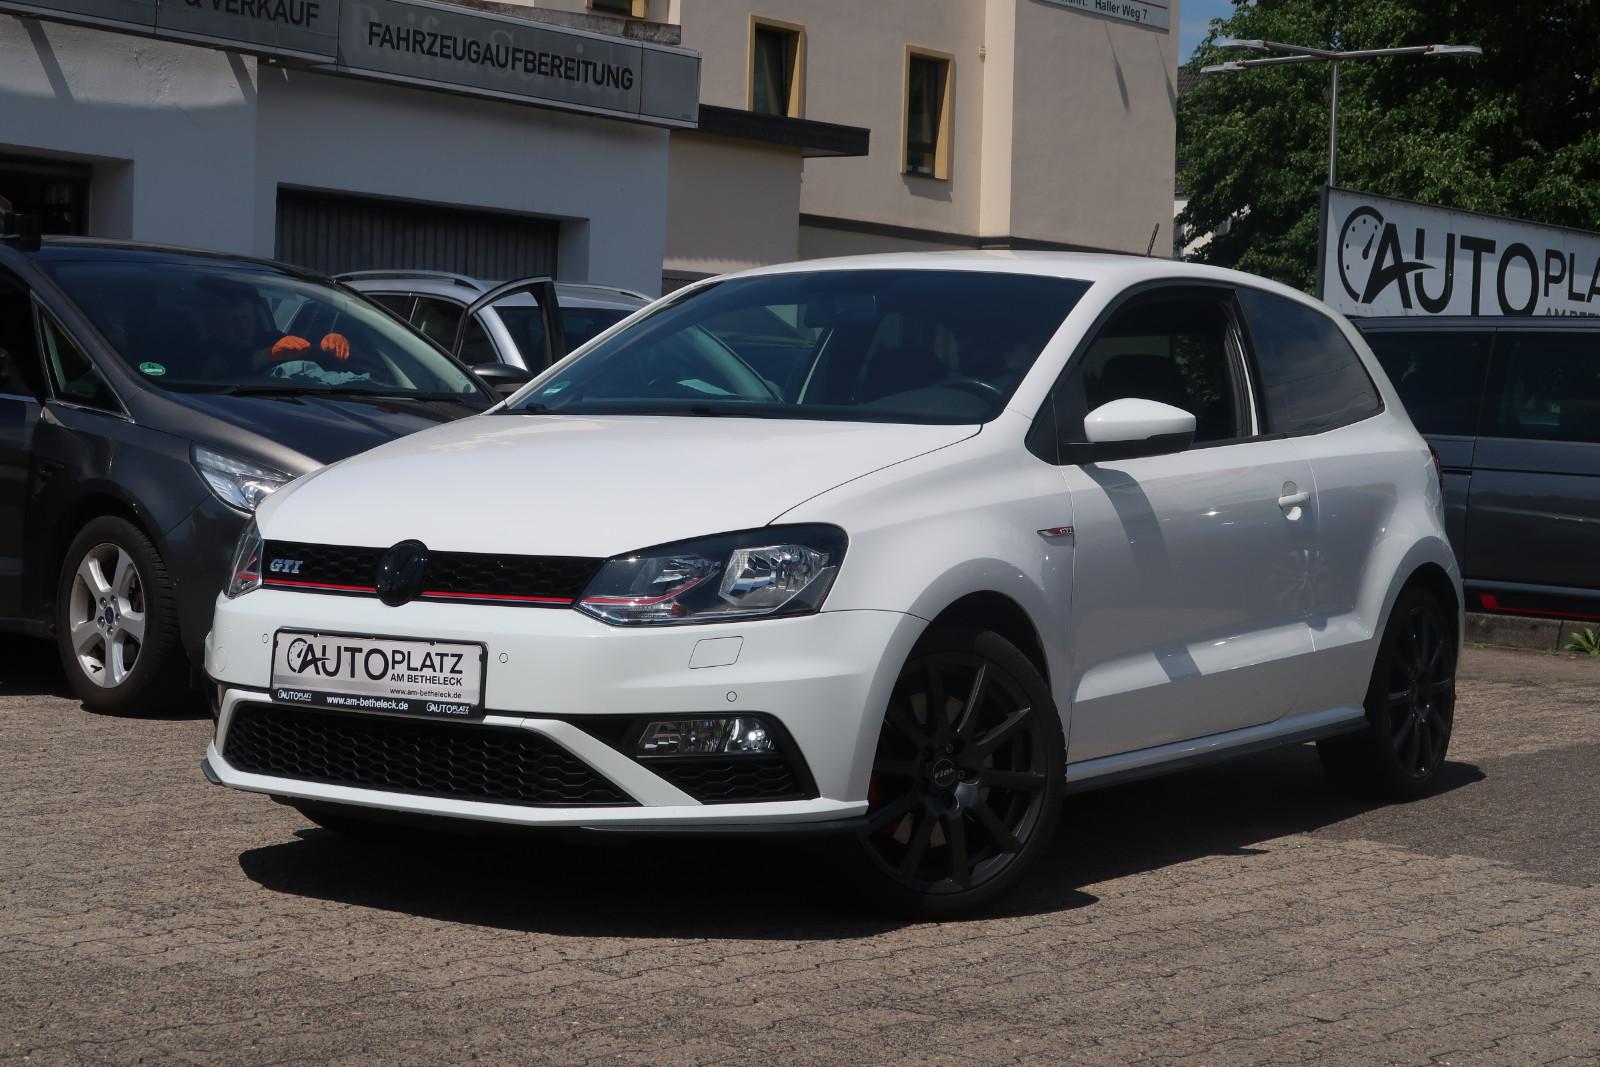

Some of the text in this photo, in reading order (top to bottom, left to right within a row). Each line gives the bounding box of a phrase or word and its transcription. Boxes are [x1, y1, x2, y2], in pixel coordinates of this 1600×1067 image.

[1095, 0, 1120, 13] Haller
[1122, 4, 1140, 21] Weg
[1142, 9, 1147, 20] 7
[368, 21, 634, 91] FAHRZEUGAUFBEREITUNG
[269, 558, 304, 574] GTI
[390, 673, 463, 686] AM BETHELECK
[390, 688, 462, 699] www.am-betheleck.de
[326, 696, 409, 711] www.am-betheleck.de
